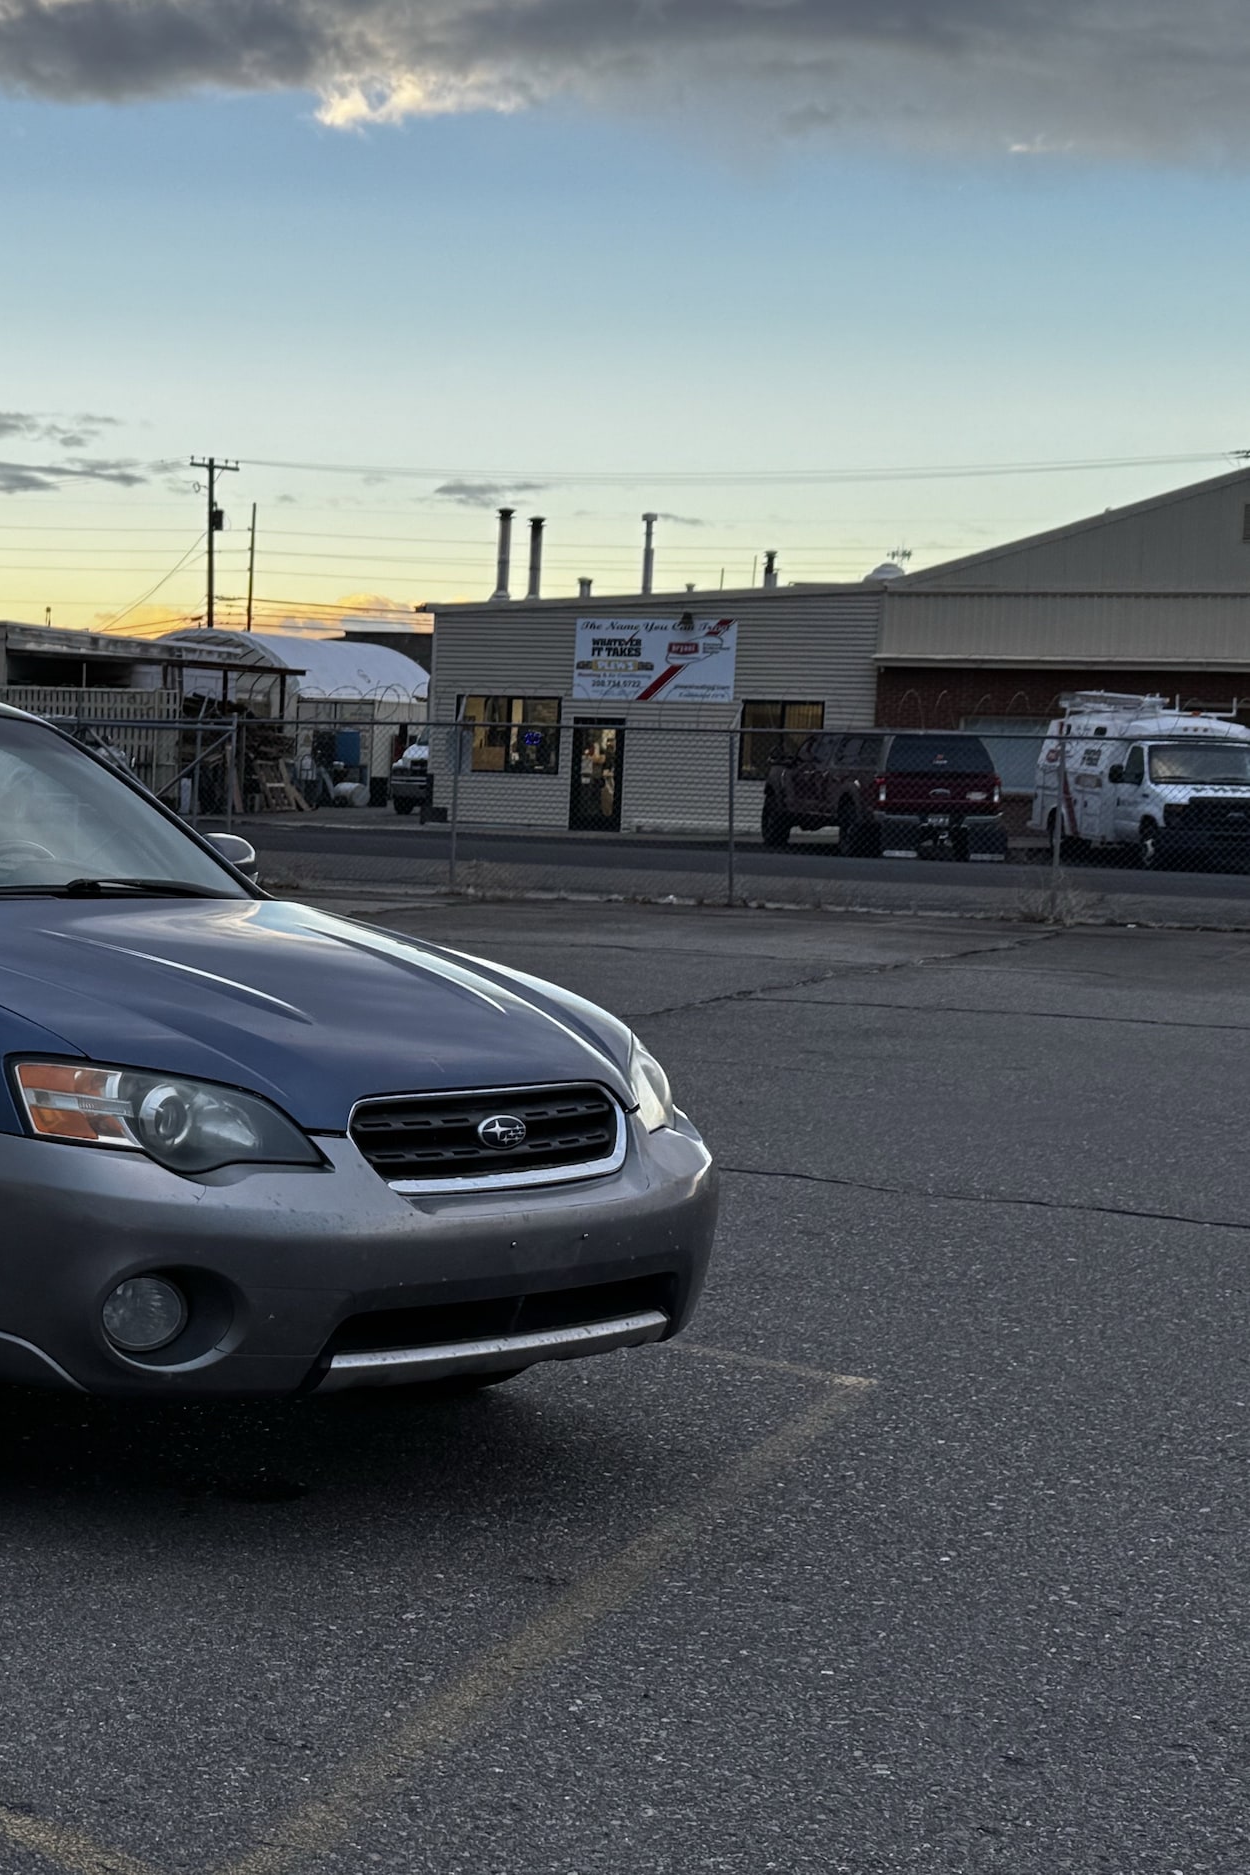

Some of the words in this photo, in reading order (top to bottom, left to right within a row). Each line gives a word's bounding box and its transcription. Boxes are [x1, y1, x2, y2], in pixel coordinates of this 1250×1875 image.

[581, 621, 603, 631] The
[606, 621, 641, 631] Name
[644, 622, 668, 632] You
[672, 622, 694, 631] Can
[592, 636, 641, 646] WHATEVER
[592, 647, 603, 657] IT
[605, 647, 641, 657] TAKES
